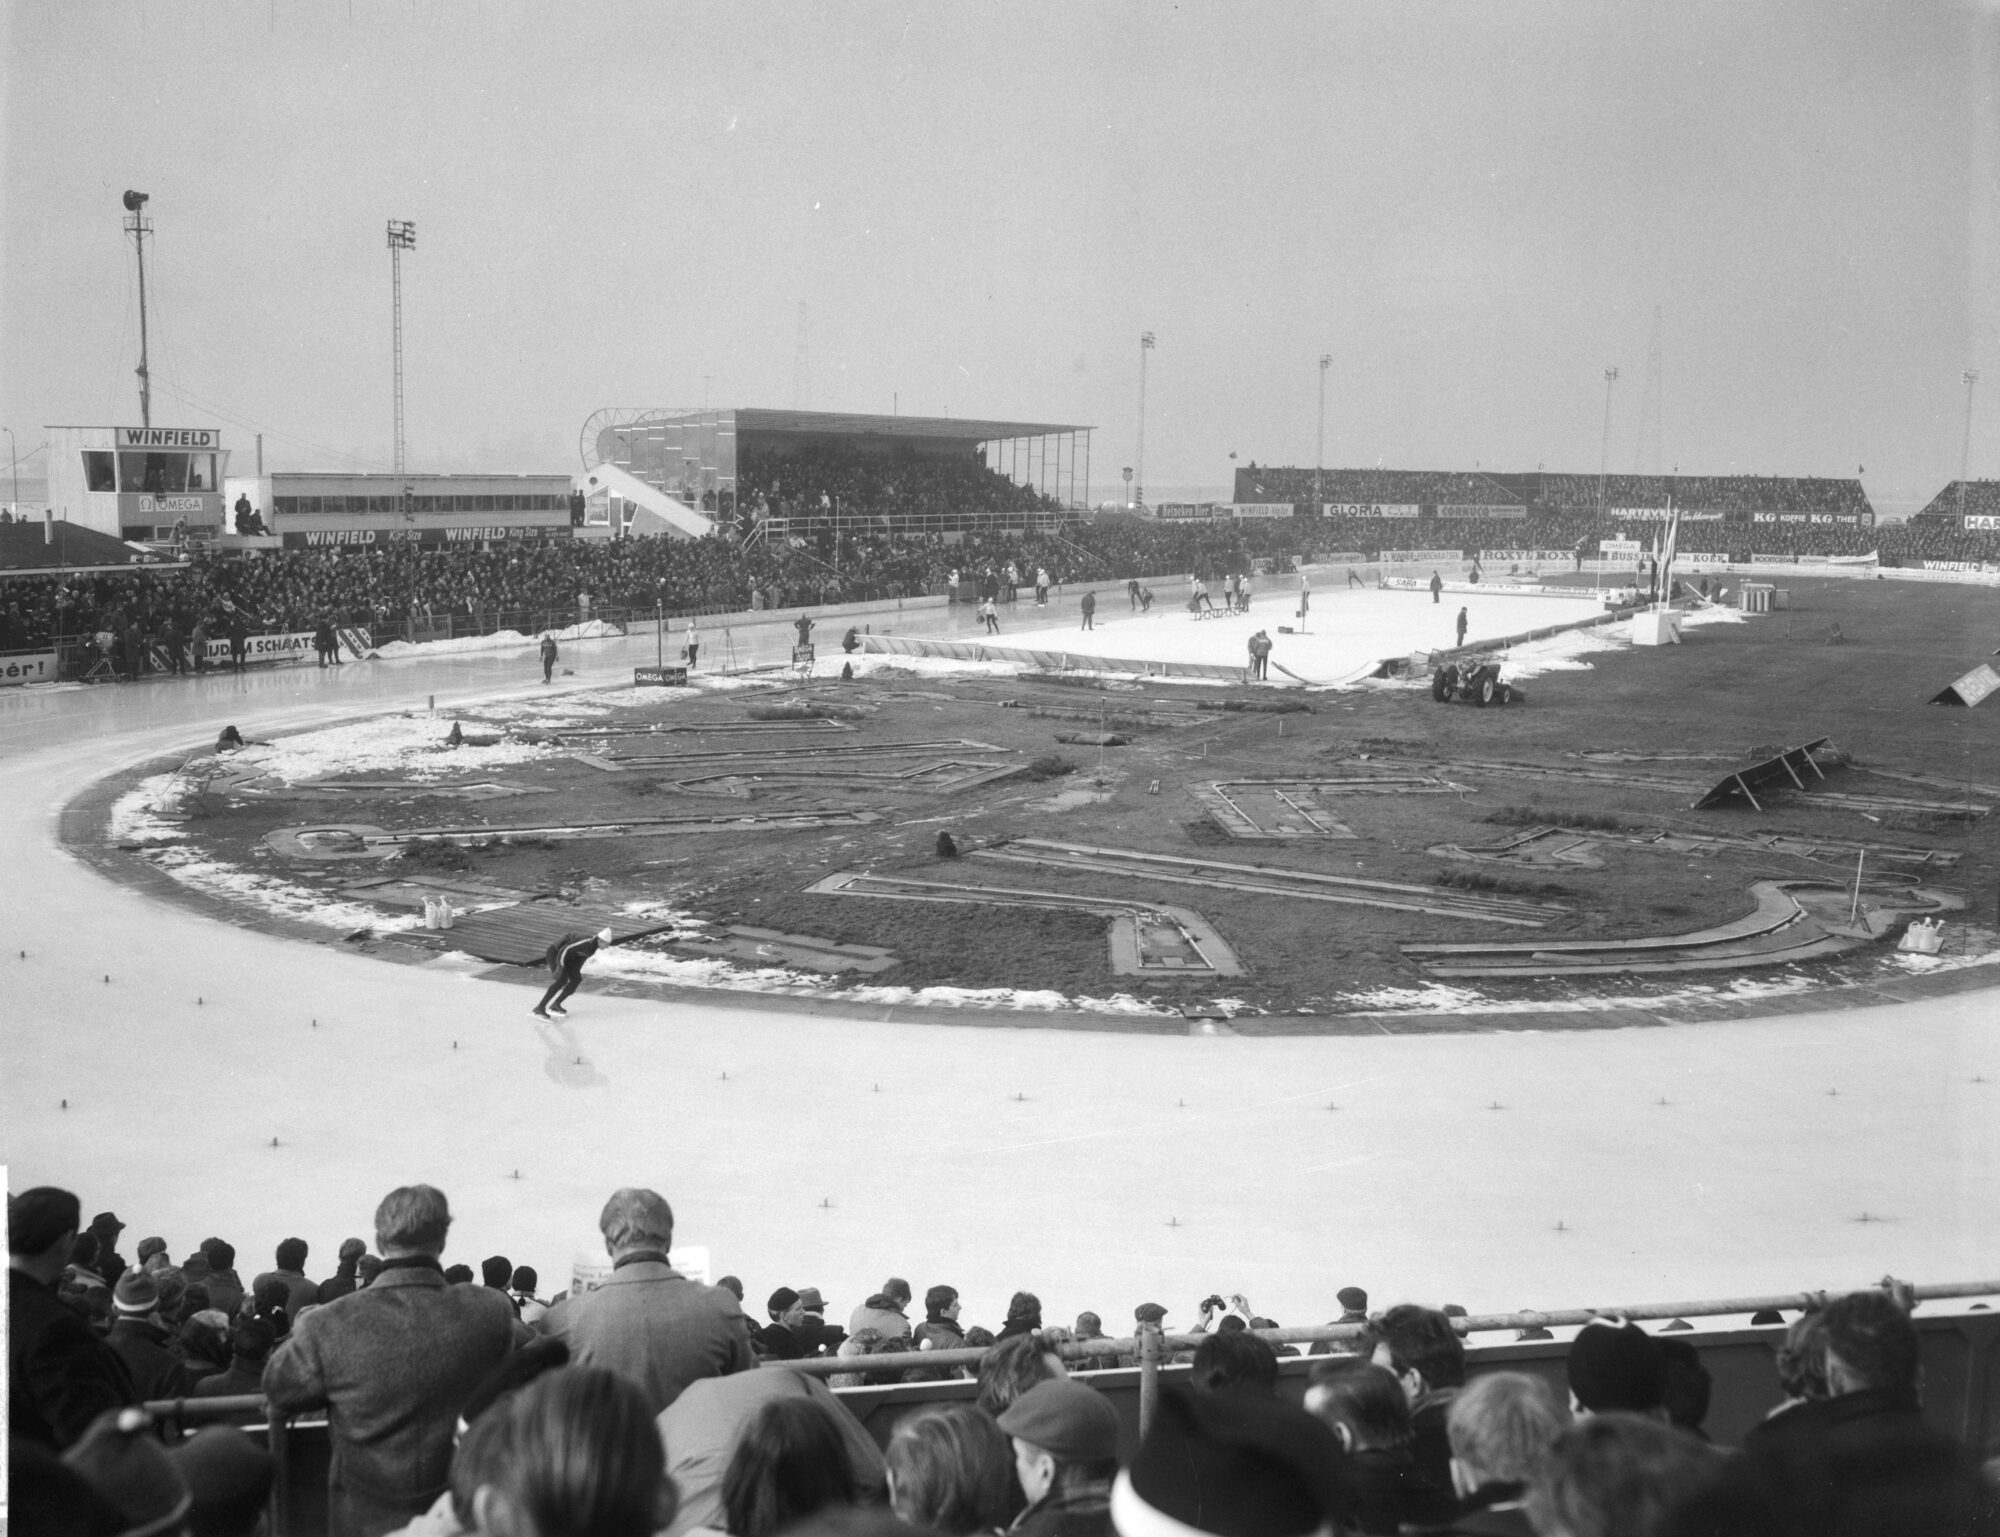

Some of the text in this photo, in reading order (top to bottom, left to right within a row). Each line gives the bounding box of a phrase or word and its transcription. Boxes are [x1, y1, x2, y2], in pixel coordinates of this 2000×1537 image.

[127, 430, 210, 446] WINFIELD
[159, 499, 201, 510] OMEGA
[1240, 505, 1268, 515] WINFIELD
[1330, 505, 1382, 516] GLORIA
[1754, 512, 1776, 522] KG
[1780, 514, 1806, 522] KOFFIE
[1811, 513, 1833, 523] KG
[1836, 515, 1858, 523] THEE
[306, 531, 376, 545] WINFIELD
[407, 530, 422, 541] Size
[446, 527, 505, 541] WINFIELD
[509, 528, 523, 539] King
[525, 527, 538, 537] Size
[1484, 551, 1526, 560] ROXY
[1693, 555, 1725, 563] KOEK
[1924, 560, 1979, 572] WINFIELD
[1544, 586, 1586, 594] Heineken
[256, 637, 317, 653] SCHAATS
[636, 672, 664, 682] OMEGA
